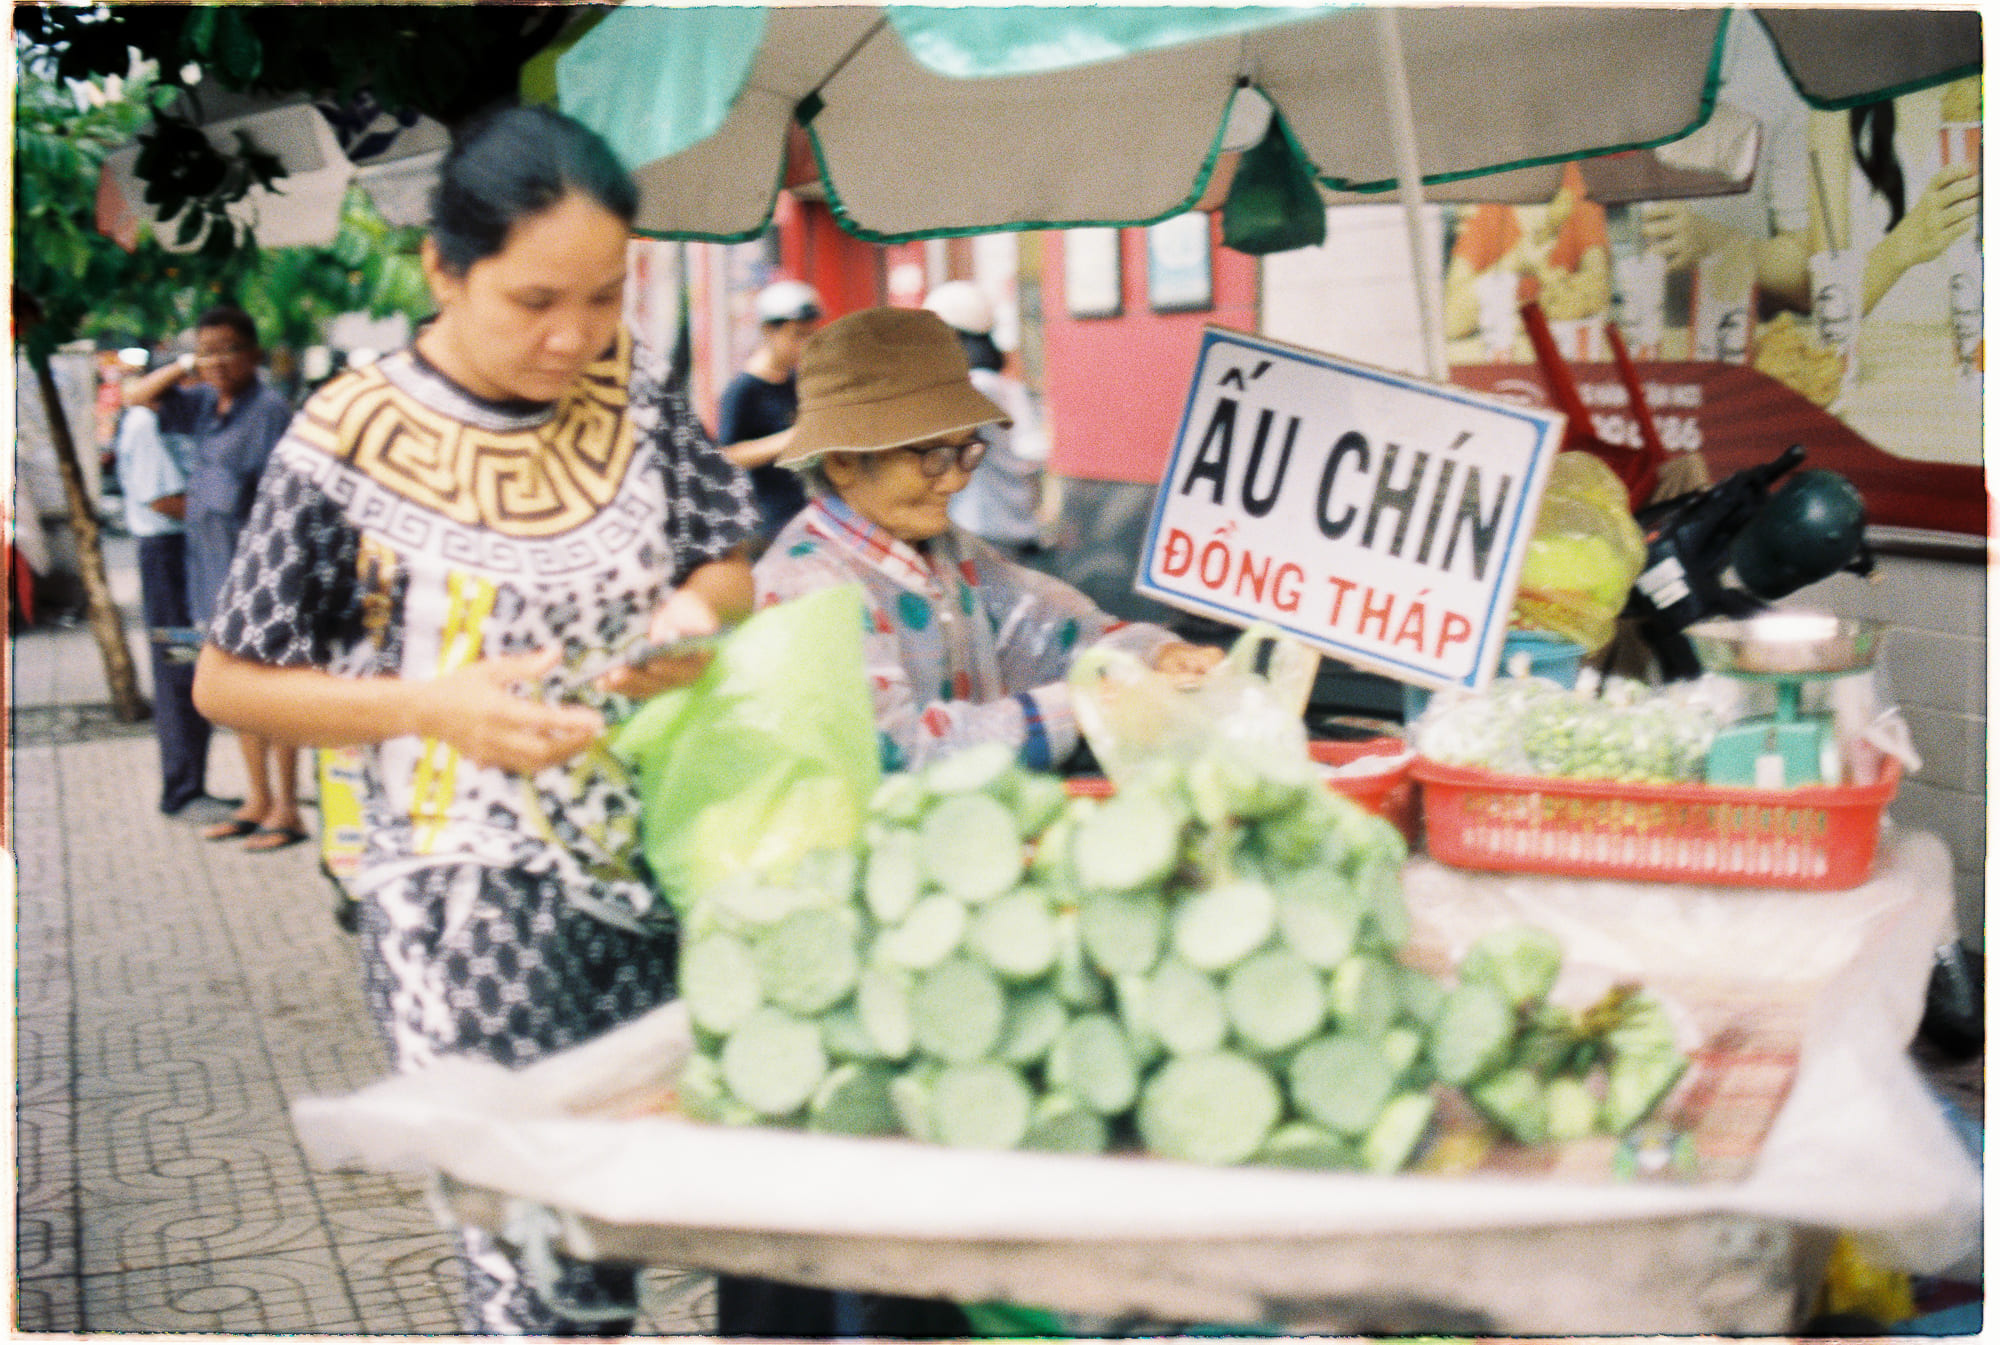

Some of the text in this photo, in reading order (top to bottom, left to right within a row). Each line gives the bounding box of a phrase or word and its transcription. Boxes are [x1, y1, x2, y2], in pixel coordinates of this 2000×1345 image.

[1181, 361, 1512, 581] ẤU CHÍN
[1328, 576, 1472, 659] THÁP
